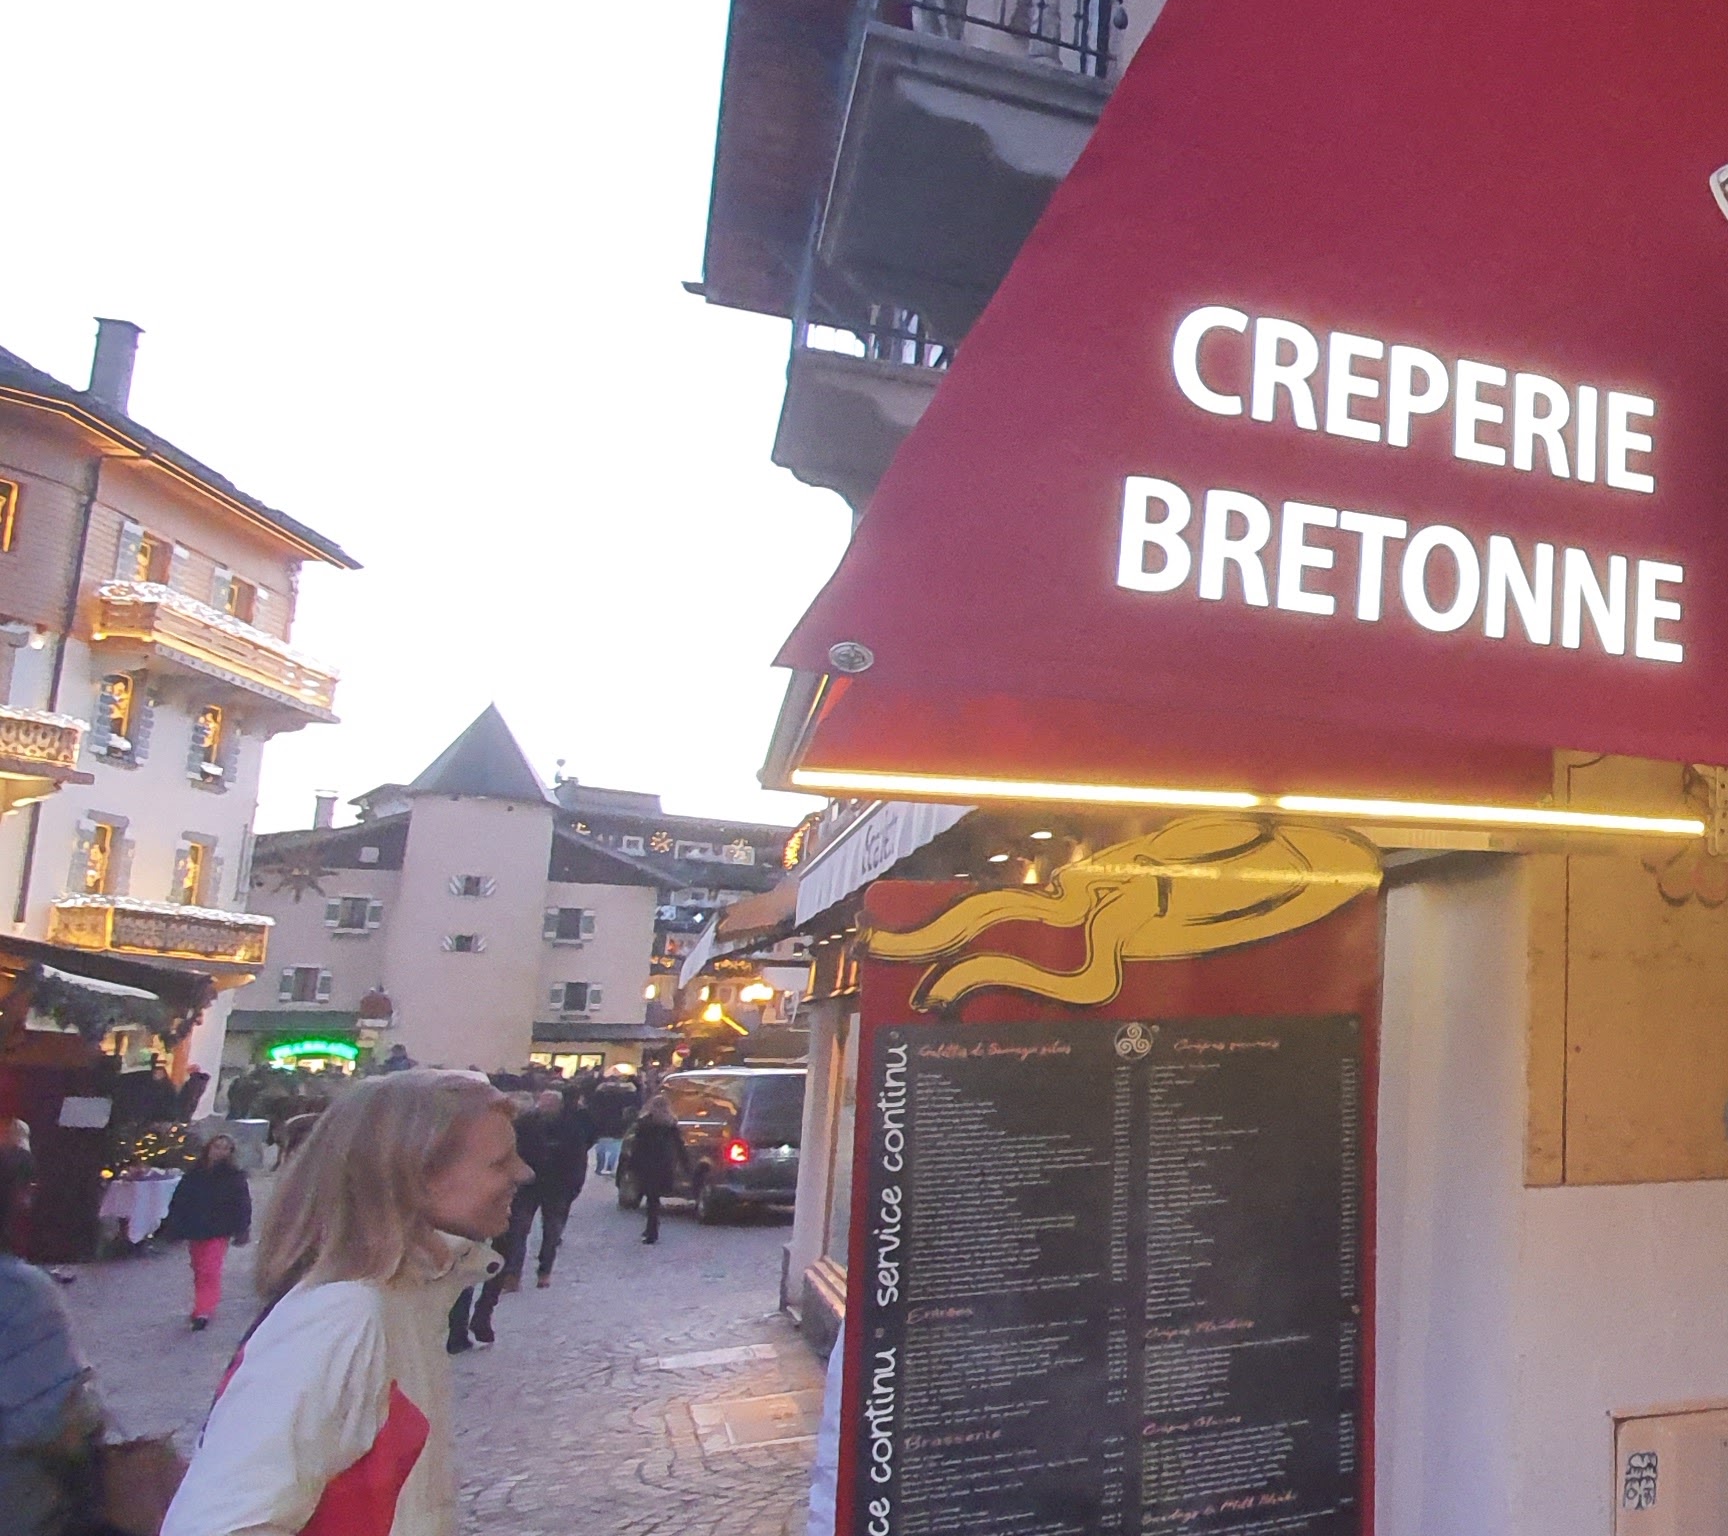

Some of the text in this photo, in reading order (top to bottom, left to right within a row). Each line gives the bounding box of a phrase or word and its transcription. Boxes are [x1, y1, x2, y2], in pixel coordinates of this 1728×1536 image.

[1172, 305, 1655, 494] CREPERIE
[1116, 474, 1684, 663] BRETONNE
[872, 1043, 908, 1308] service continu
[864, 1346, 897, 1484] continu
